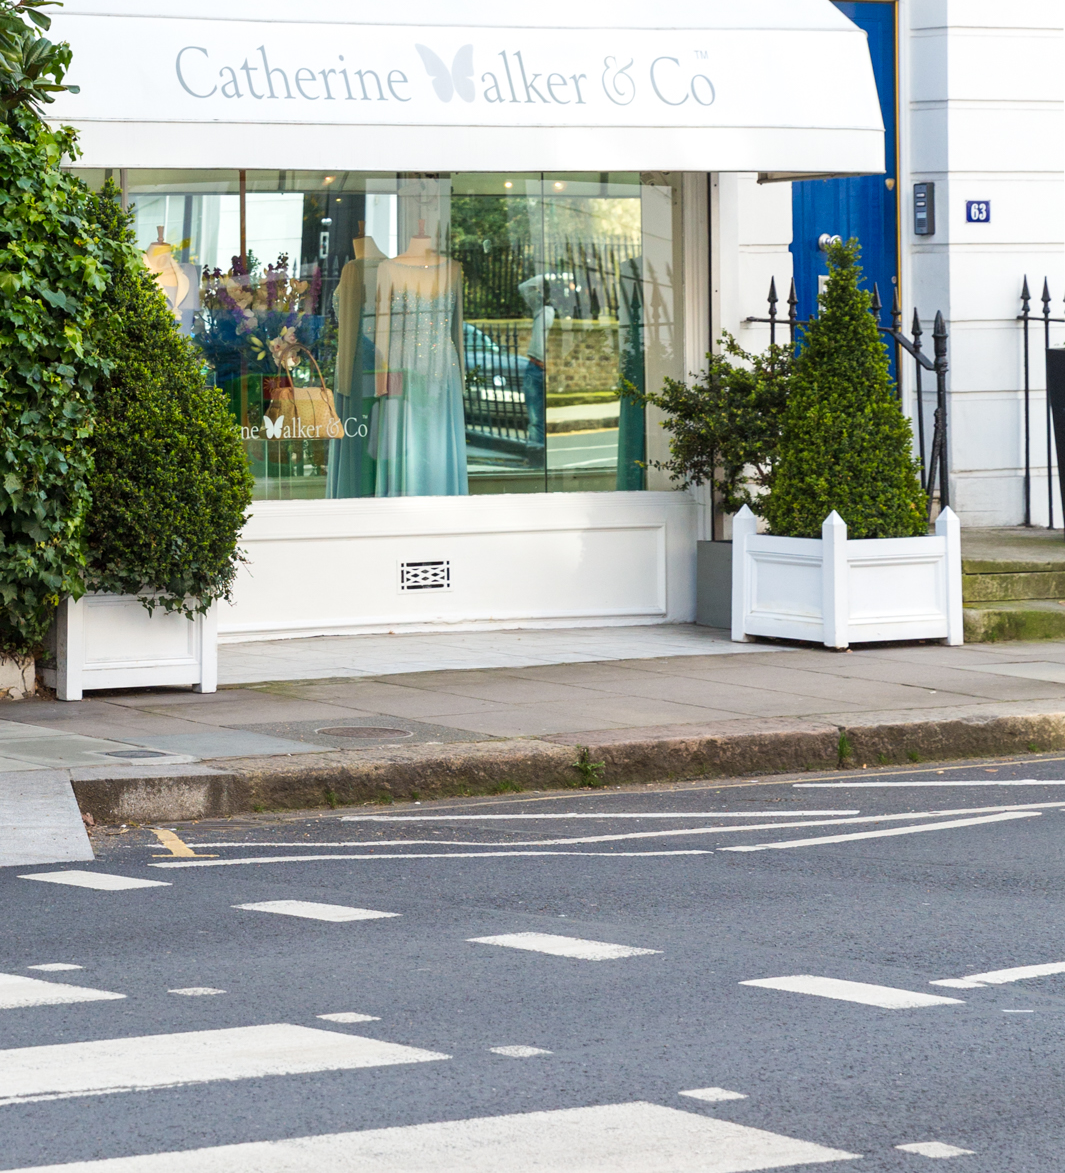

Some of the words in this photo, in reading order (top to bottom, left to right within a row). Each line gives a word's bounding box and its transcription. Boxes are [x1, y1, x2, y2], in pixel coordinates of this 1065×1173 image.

[175, 44, 412, 102] Catherine
[601, 55, 636, 106] &
[970, 203, 987, 220] 63
